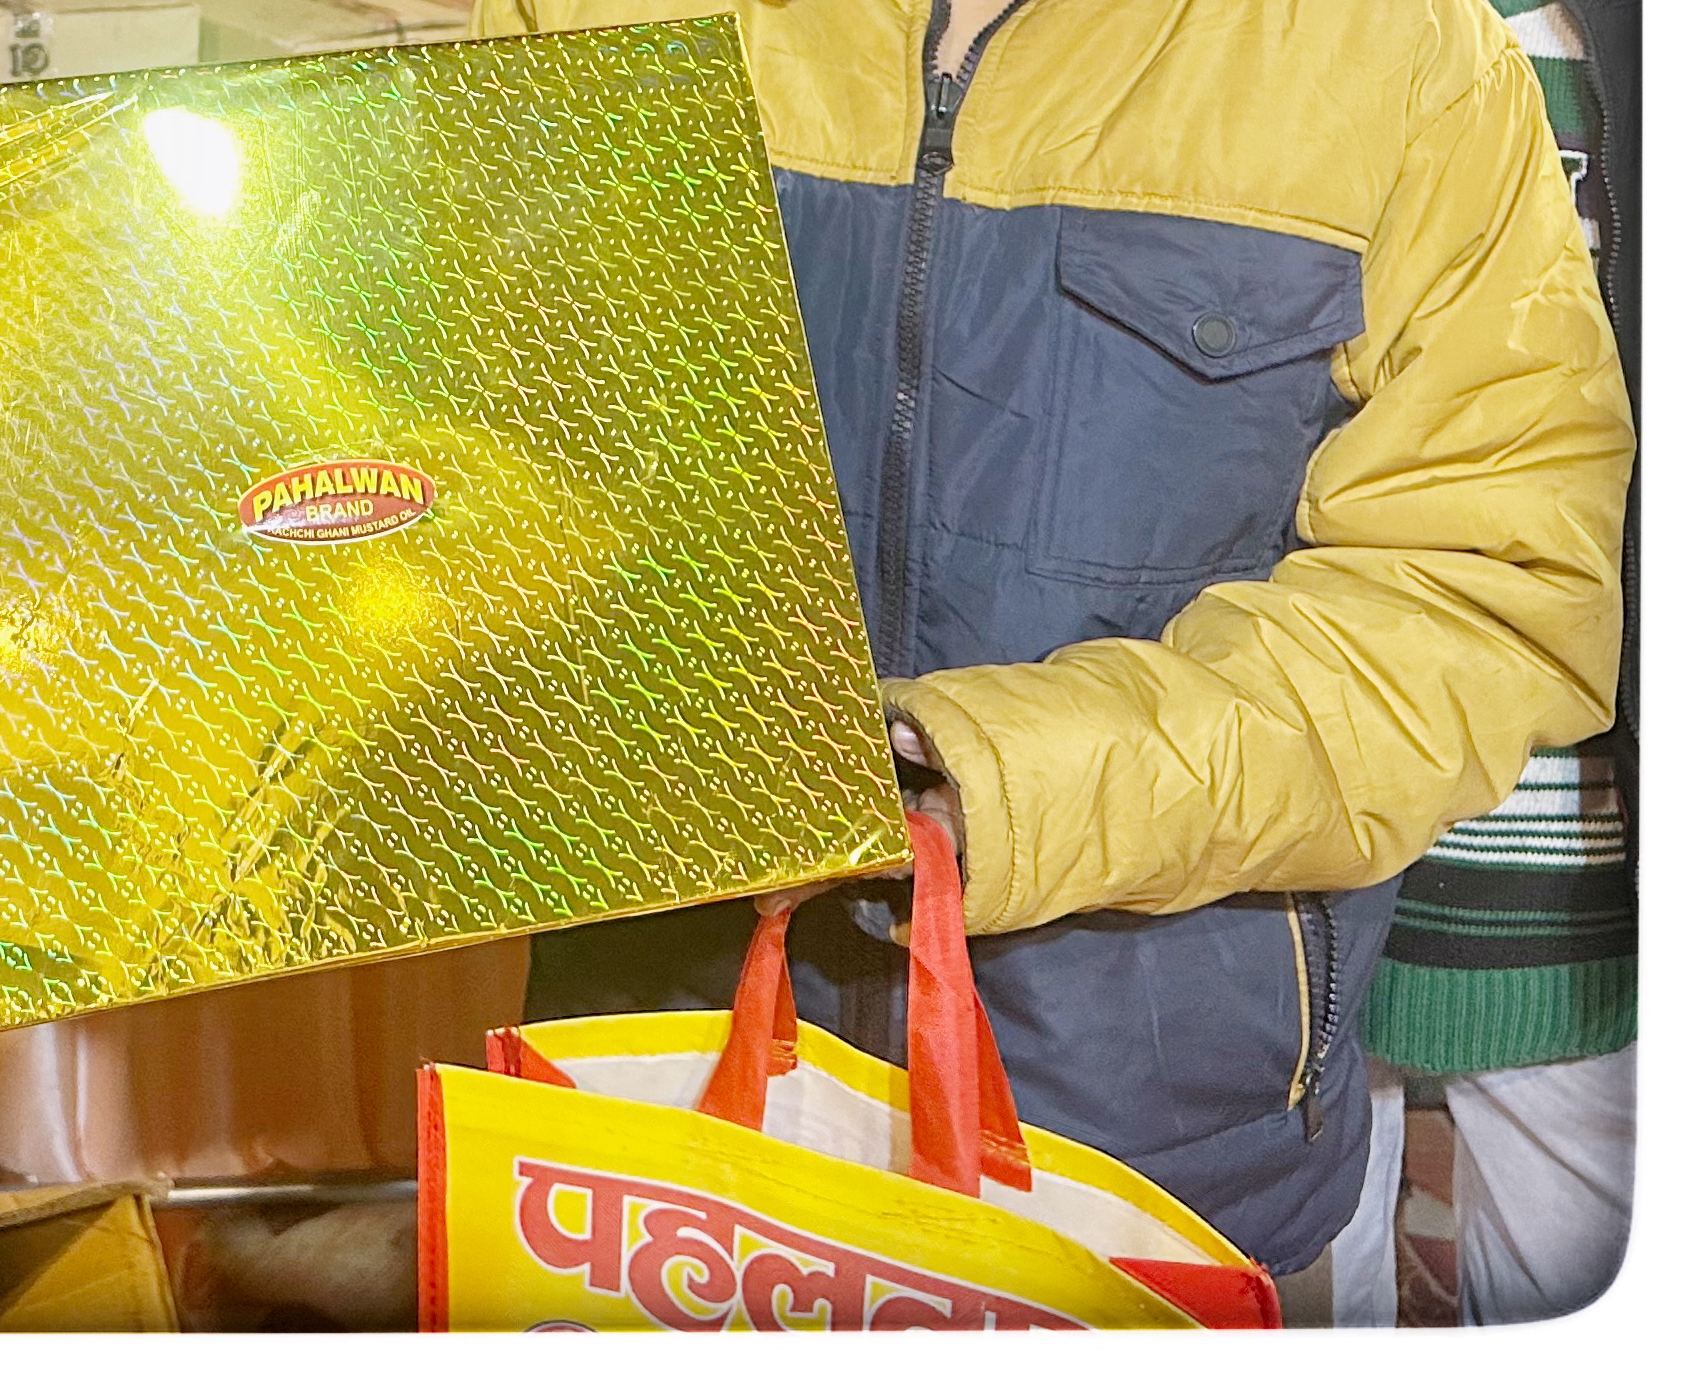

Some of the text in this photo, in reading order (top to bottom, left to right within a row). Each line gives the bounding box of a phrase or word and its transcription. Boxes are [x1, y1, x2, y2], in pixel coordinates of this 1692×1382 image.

[252, 467, 425, 524] PAHALWAN
[305, 498, 375, 523] BRAND
[316, 526, 350, 539] GHANI
[351, 515, 399, 537] MUSTARD
[399, 509, 417, 523] OIL
